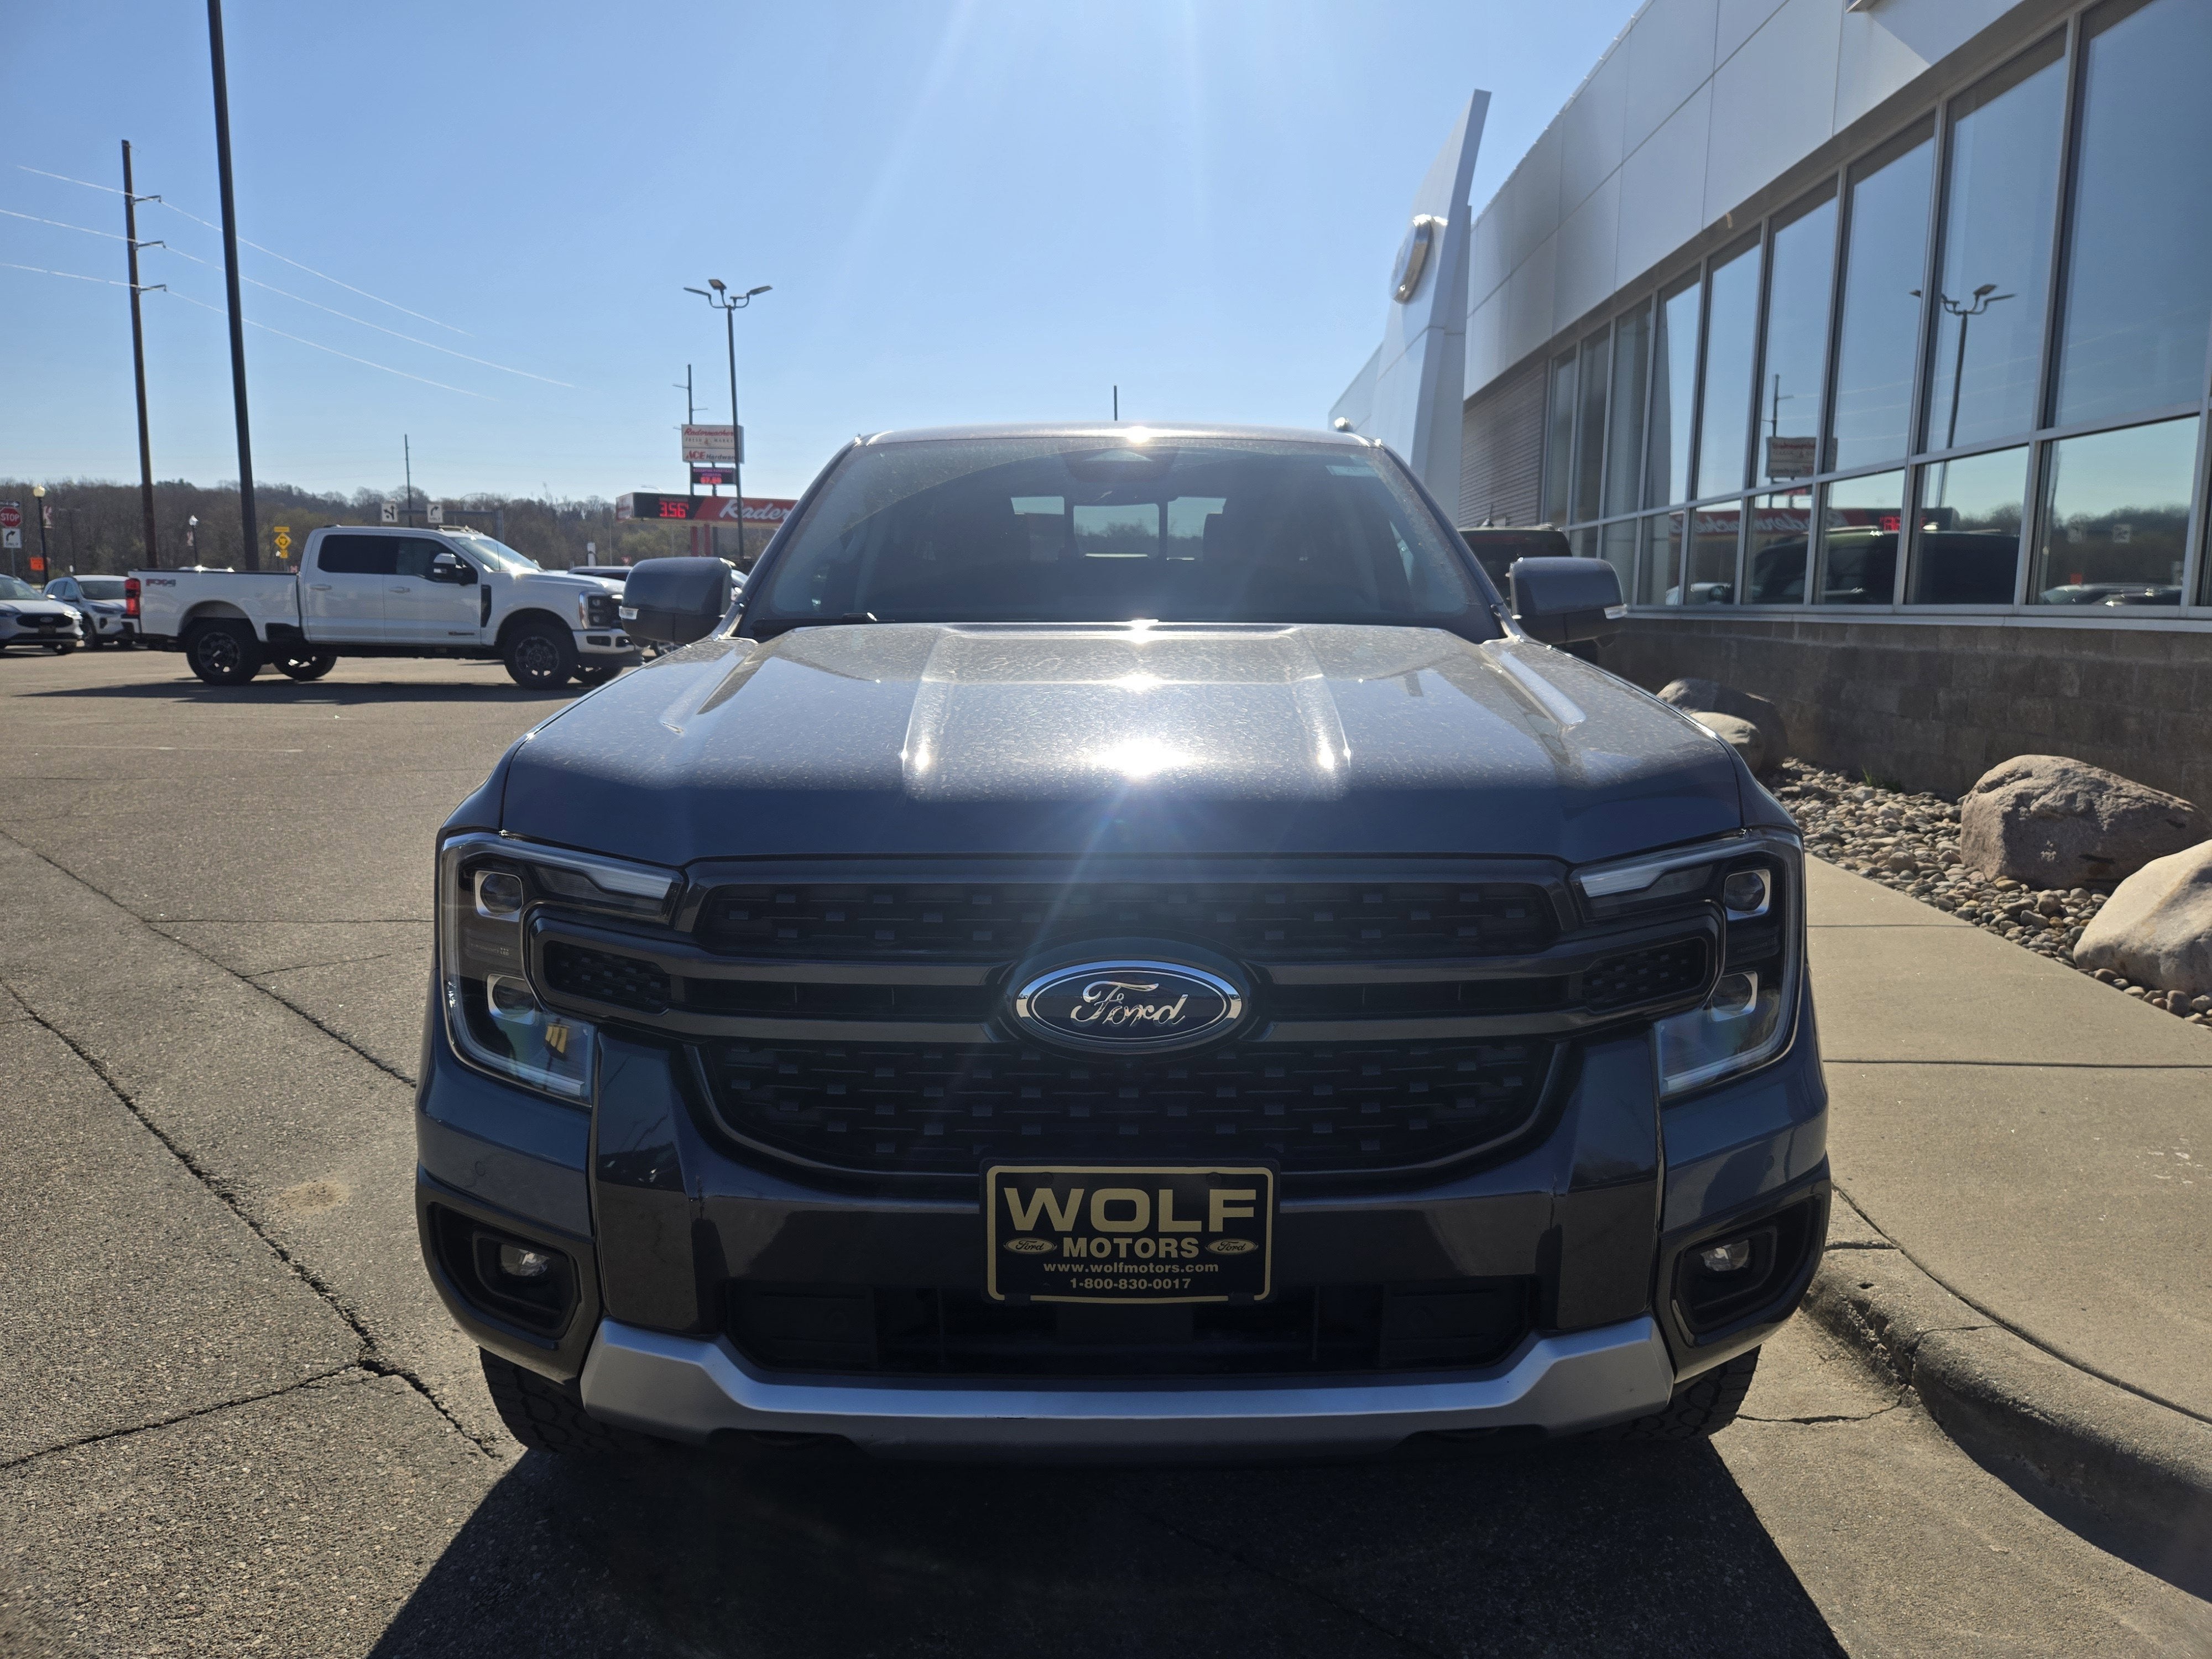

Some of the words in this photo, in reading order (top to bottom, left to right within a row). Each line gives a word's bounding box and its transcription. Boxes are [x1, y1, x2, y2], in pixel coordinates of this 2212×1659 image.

[686, 450, 706, 460] ACE
[1, 513, 20, 522] STOP
[1071, 980, 1188, 1027] Ford
[1004, 1187, 1256, 1233] WOLF
[1015, 1240, 1045, 1251] Ford
[1063, 1237, 1199, 1259] MOTORS
[1217, 1241, 1246, 1252] Ford
[1043, 1262, 1219, 1273] www.wolfmotors.com
[1070, 1277, 1191, 1290] 1-800-830-0017
